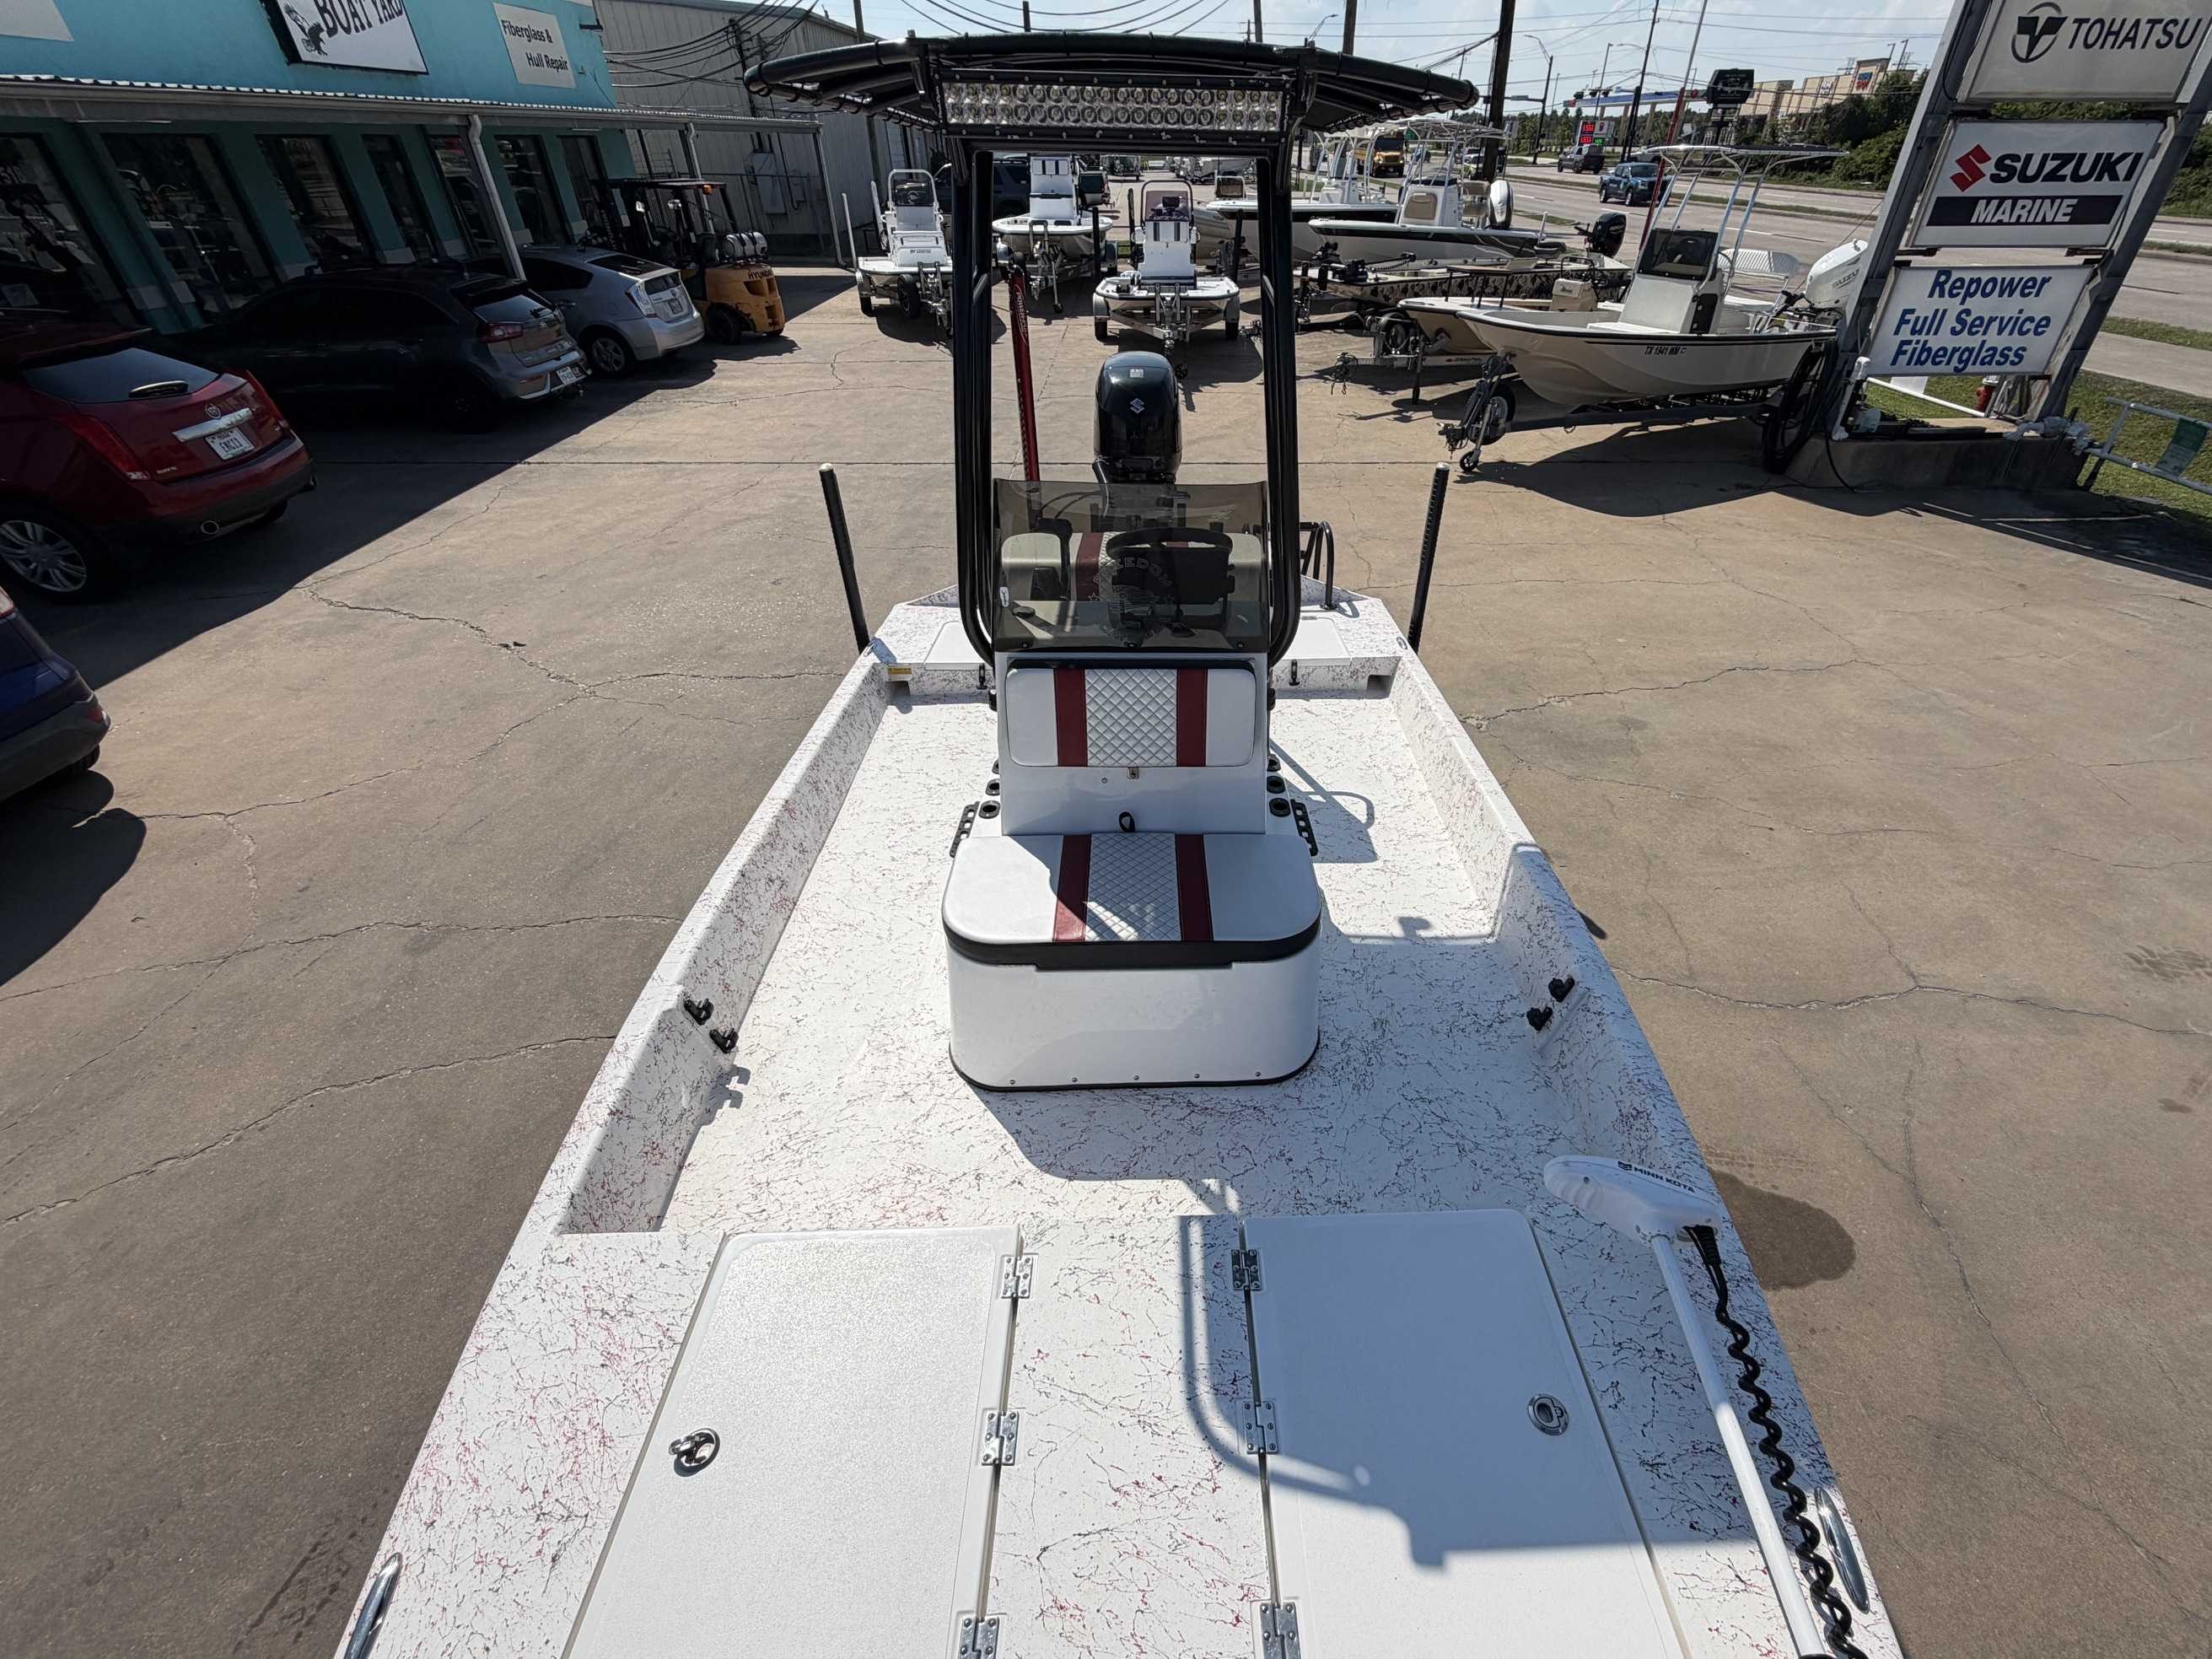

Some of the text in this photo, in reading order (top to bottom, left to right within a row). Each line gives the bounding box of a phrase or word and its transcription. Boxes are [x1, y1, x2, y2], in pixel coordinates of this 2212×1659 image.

[501, 19, 553, 43] Fiberglass &
[2067, 17, 2202, 50] TOHATSU
[525, 52, 568, 73] Hull Repair
[1989, 152, 2144, 184] SUZUKI
[1970, 197, 2079, 224] MARINE
[1833, 268, 1860, 287] SUZU
[1927, 269, 2053, 305] Repower
[1892, 308, 2052, 337] Full Service
[1890, 339, 2027, 374] Fiberglass
[1633, 1166, 1695, 1193] MINN KOTA
